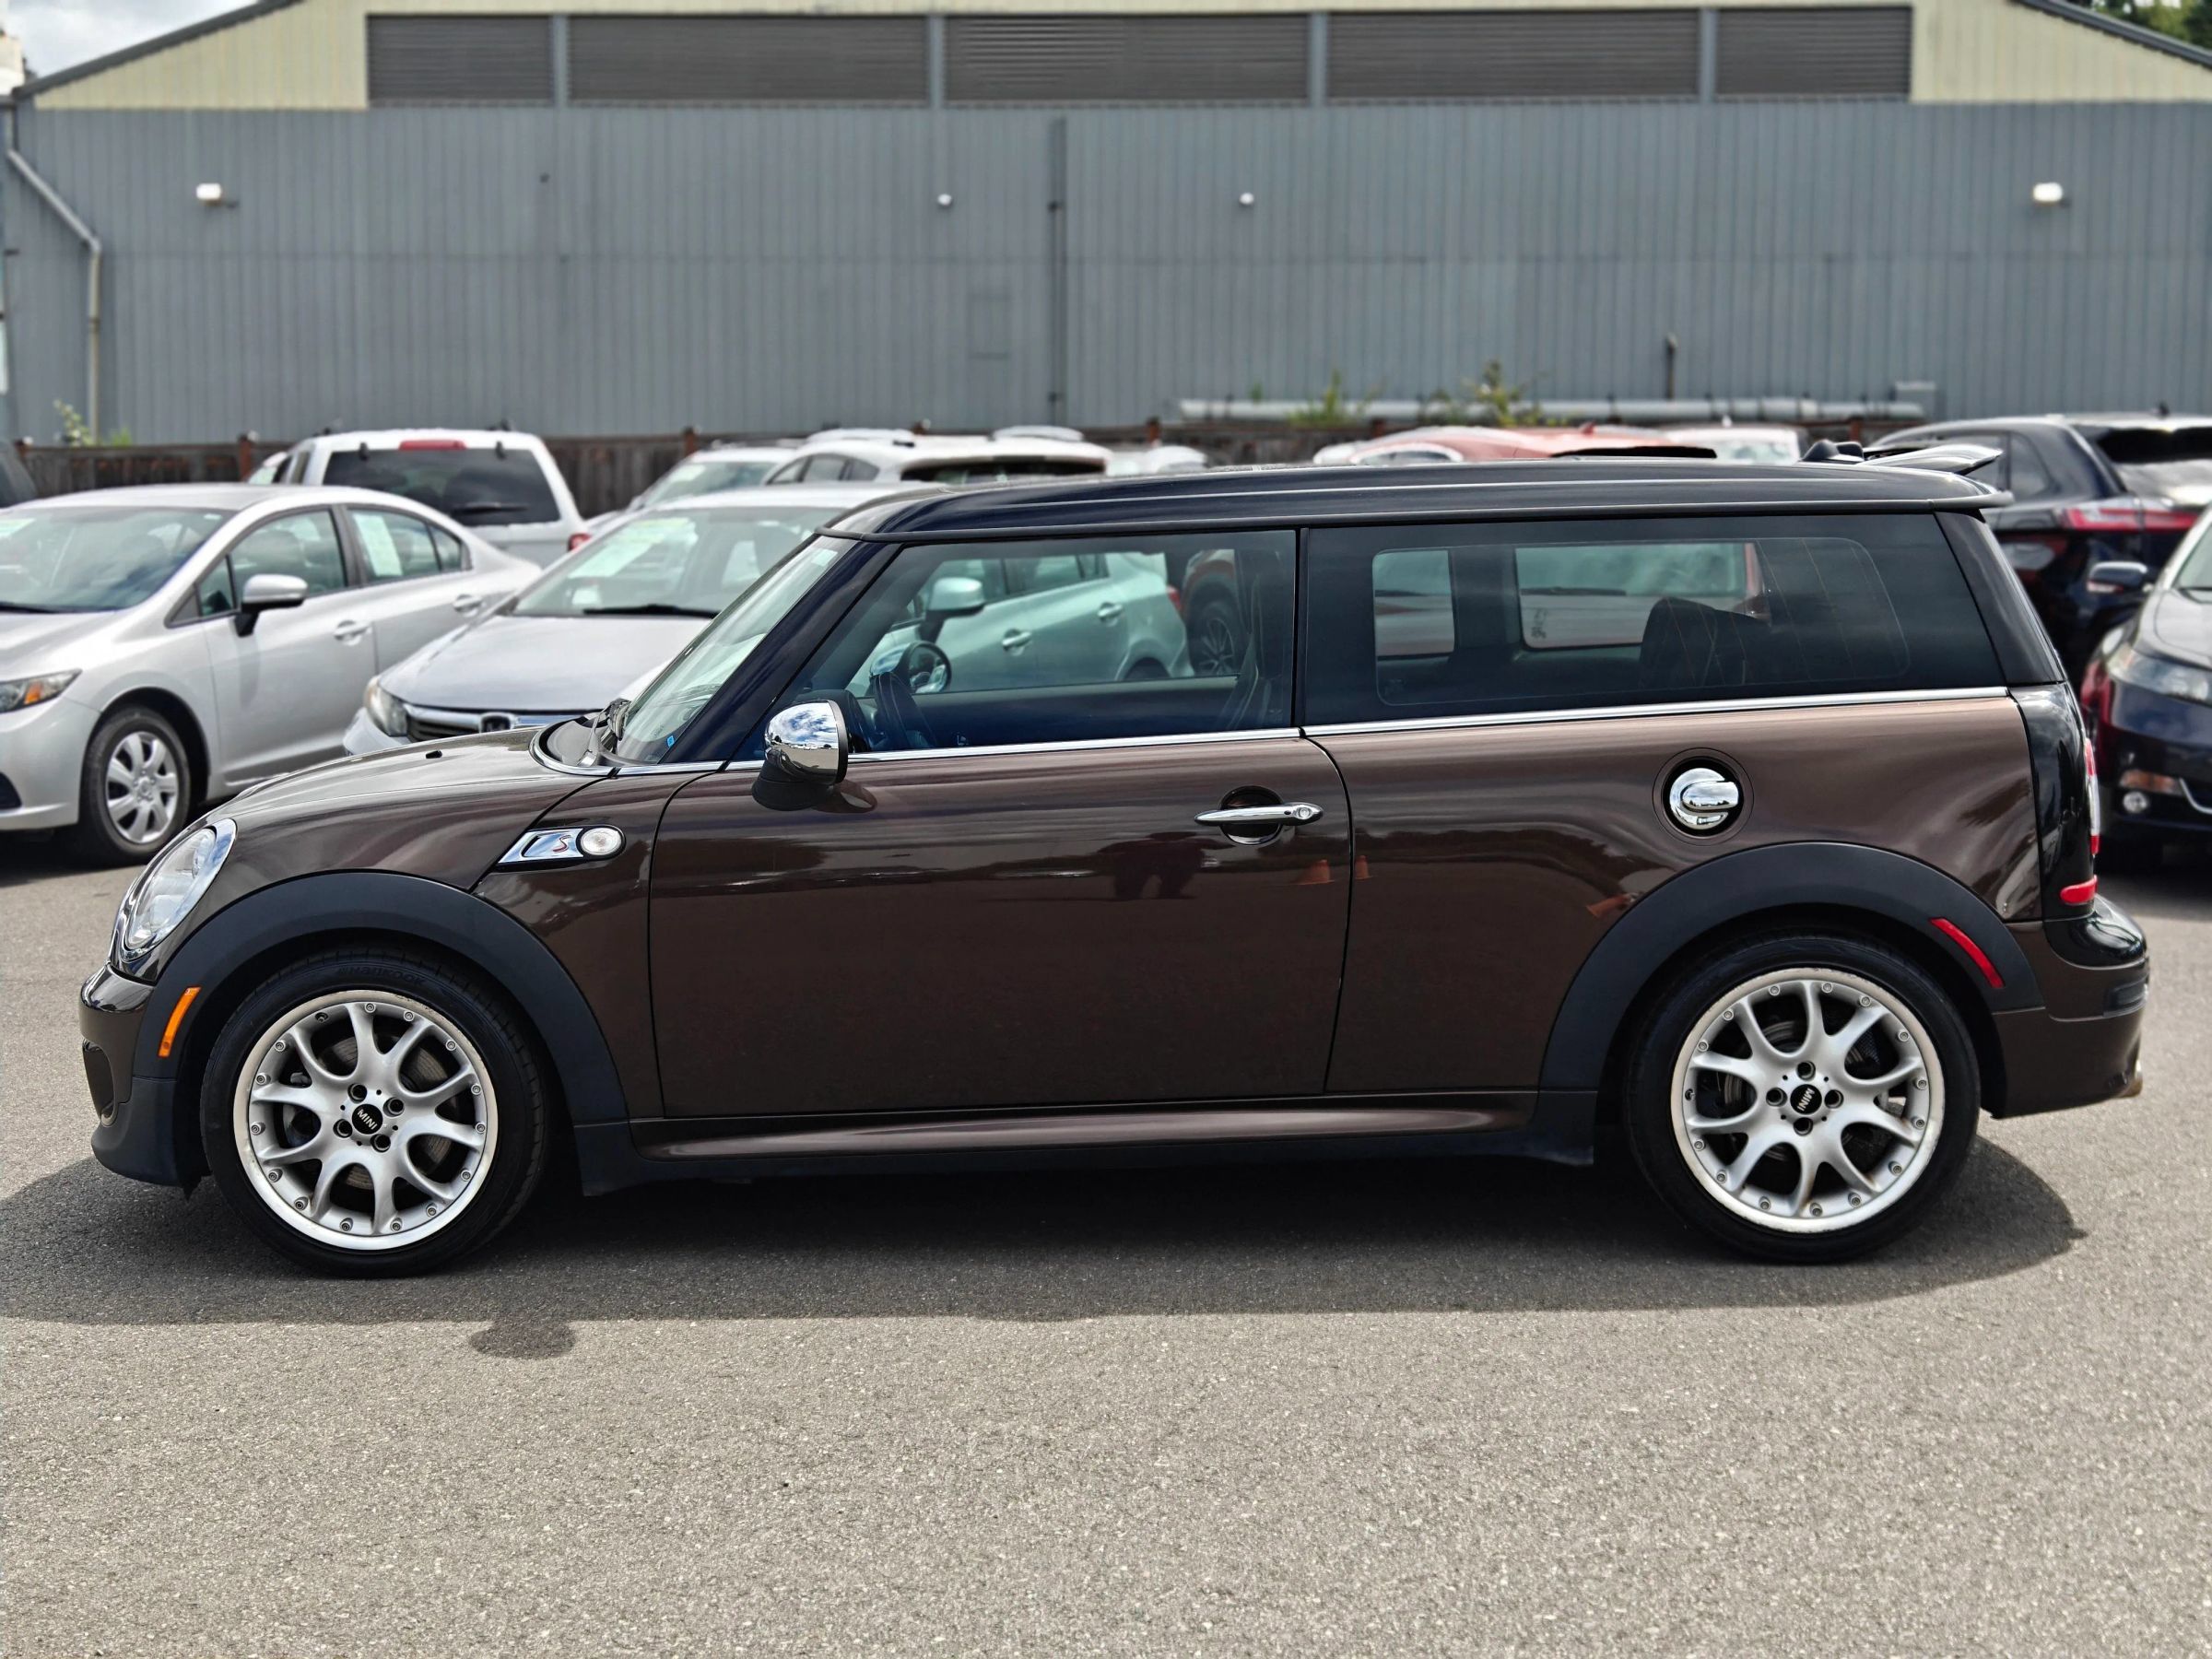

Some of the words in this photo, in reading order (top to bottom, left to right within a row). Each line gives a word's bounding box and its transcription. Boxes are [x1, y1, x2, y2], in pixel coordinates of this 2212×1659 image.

[552, 834, 572, 853] S
[1796, 1087, 1816, 1112] MINI
[357, 1109, 378, 1130] MINI
